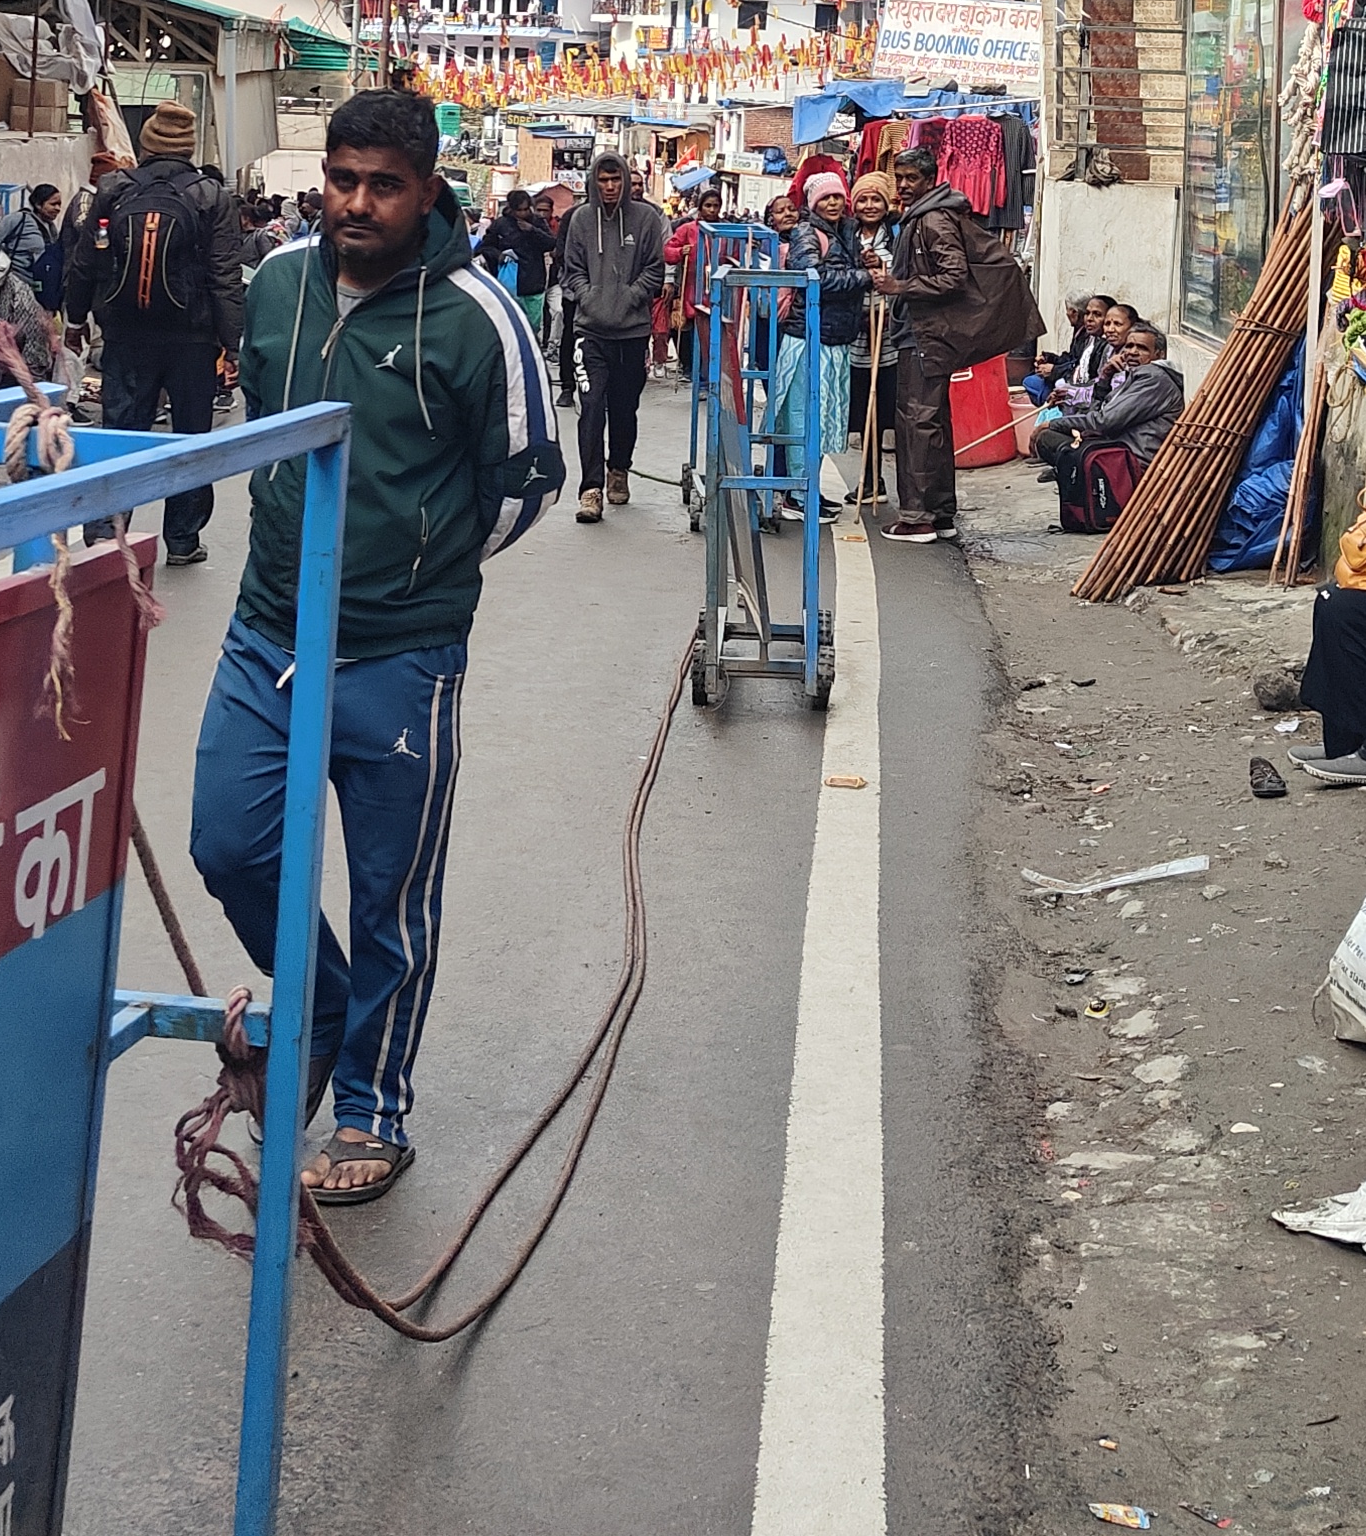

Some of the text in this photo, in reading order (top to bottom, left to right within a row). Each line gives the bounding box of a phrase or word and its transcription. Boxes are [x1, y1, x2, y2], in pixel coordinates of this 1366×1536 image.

[881, 30, 1031, 62] BUS BOOKING OFFICE
[15, 768, 106, 939] का
